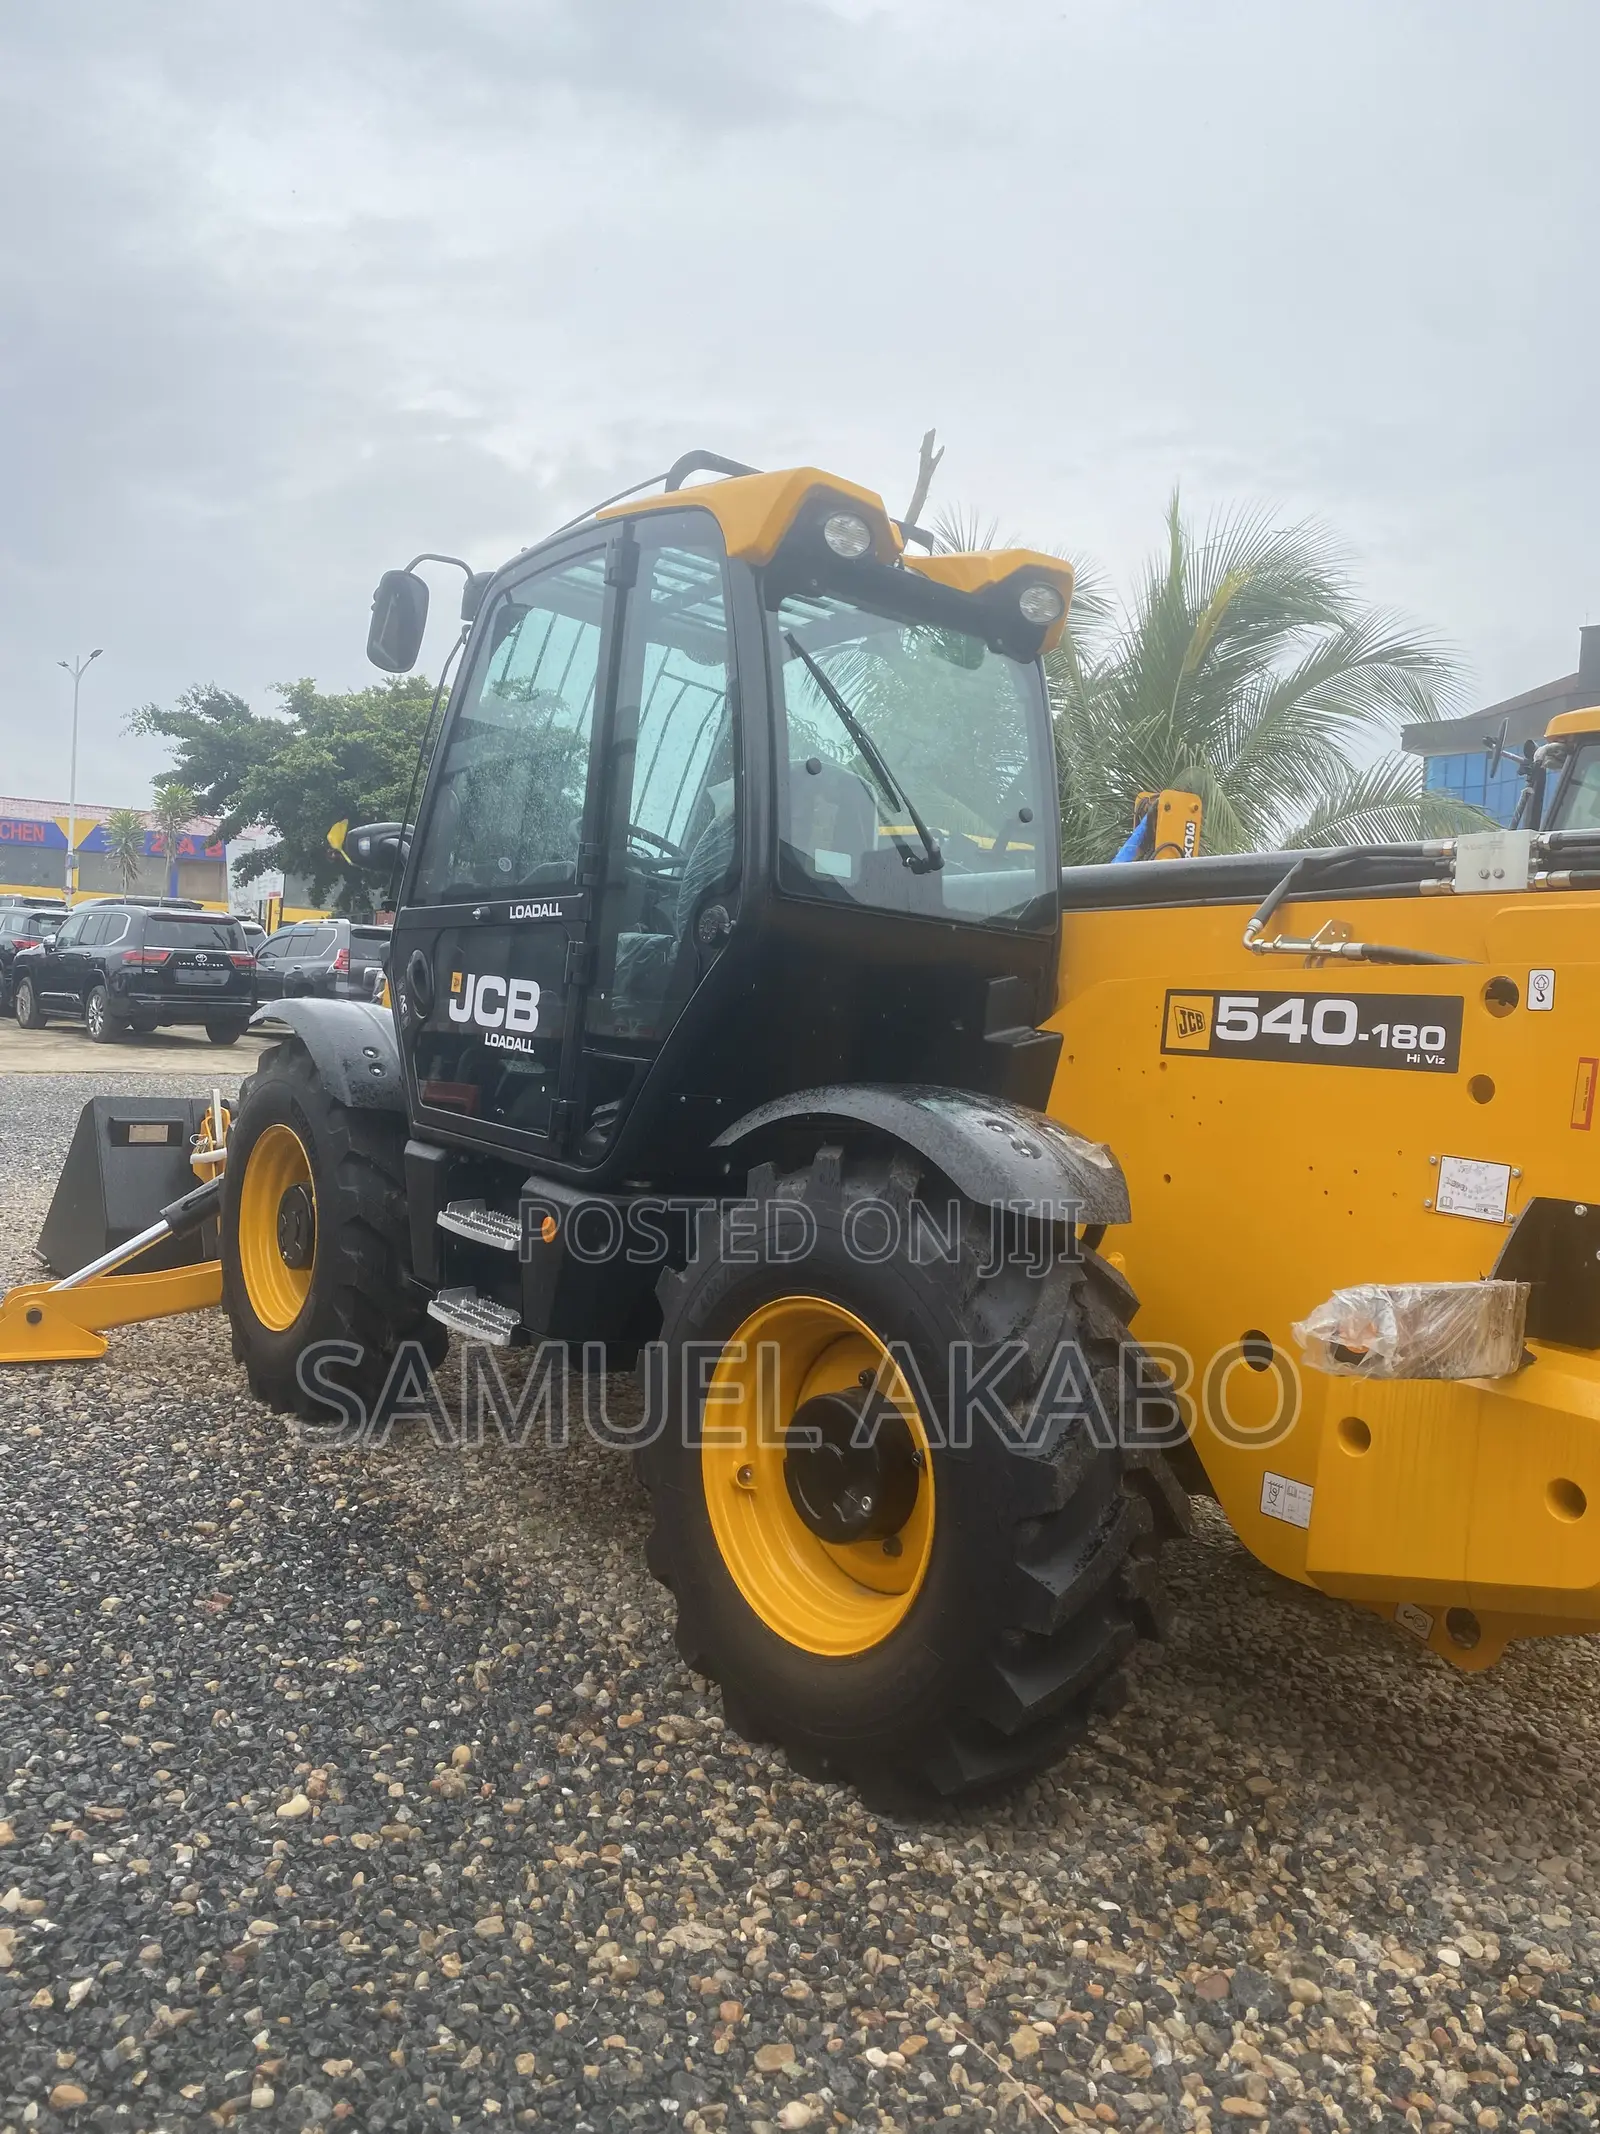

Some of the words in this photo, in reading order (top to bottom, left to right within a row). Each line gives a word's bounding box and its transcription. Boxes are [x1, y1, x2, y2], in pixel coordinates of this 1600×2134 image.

[0, 821, 45, 842] CHEN
[1184, 822, 1196, 858] 3CX
[509, 903, 563, 919] LOADALL
[449, 973, 540, 1033] JCB
[1177, 1009, 1205, 1035] JCB
[484, 1032, 535, 1054] LOADALL
[1406, 1053, 1421, 1064] Hi
[1425, 1054, 1446, 1065] Viz
